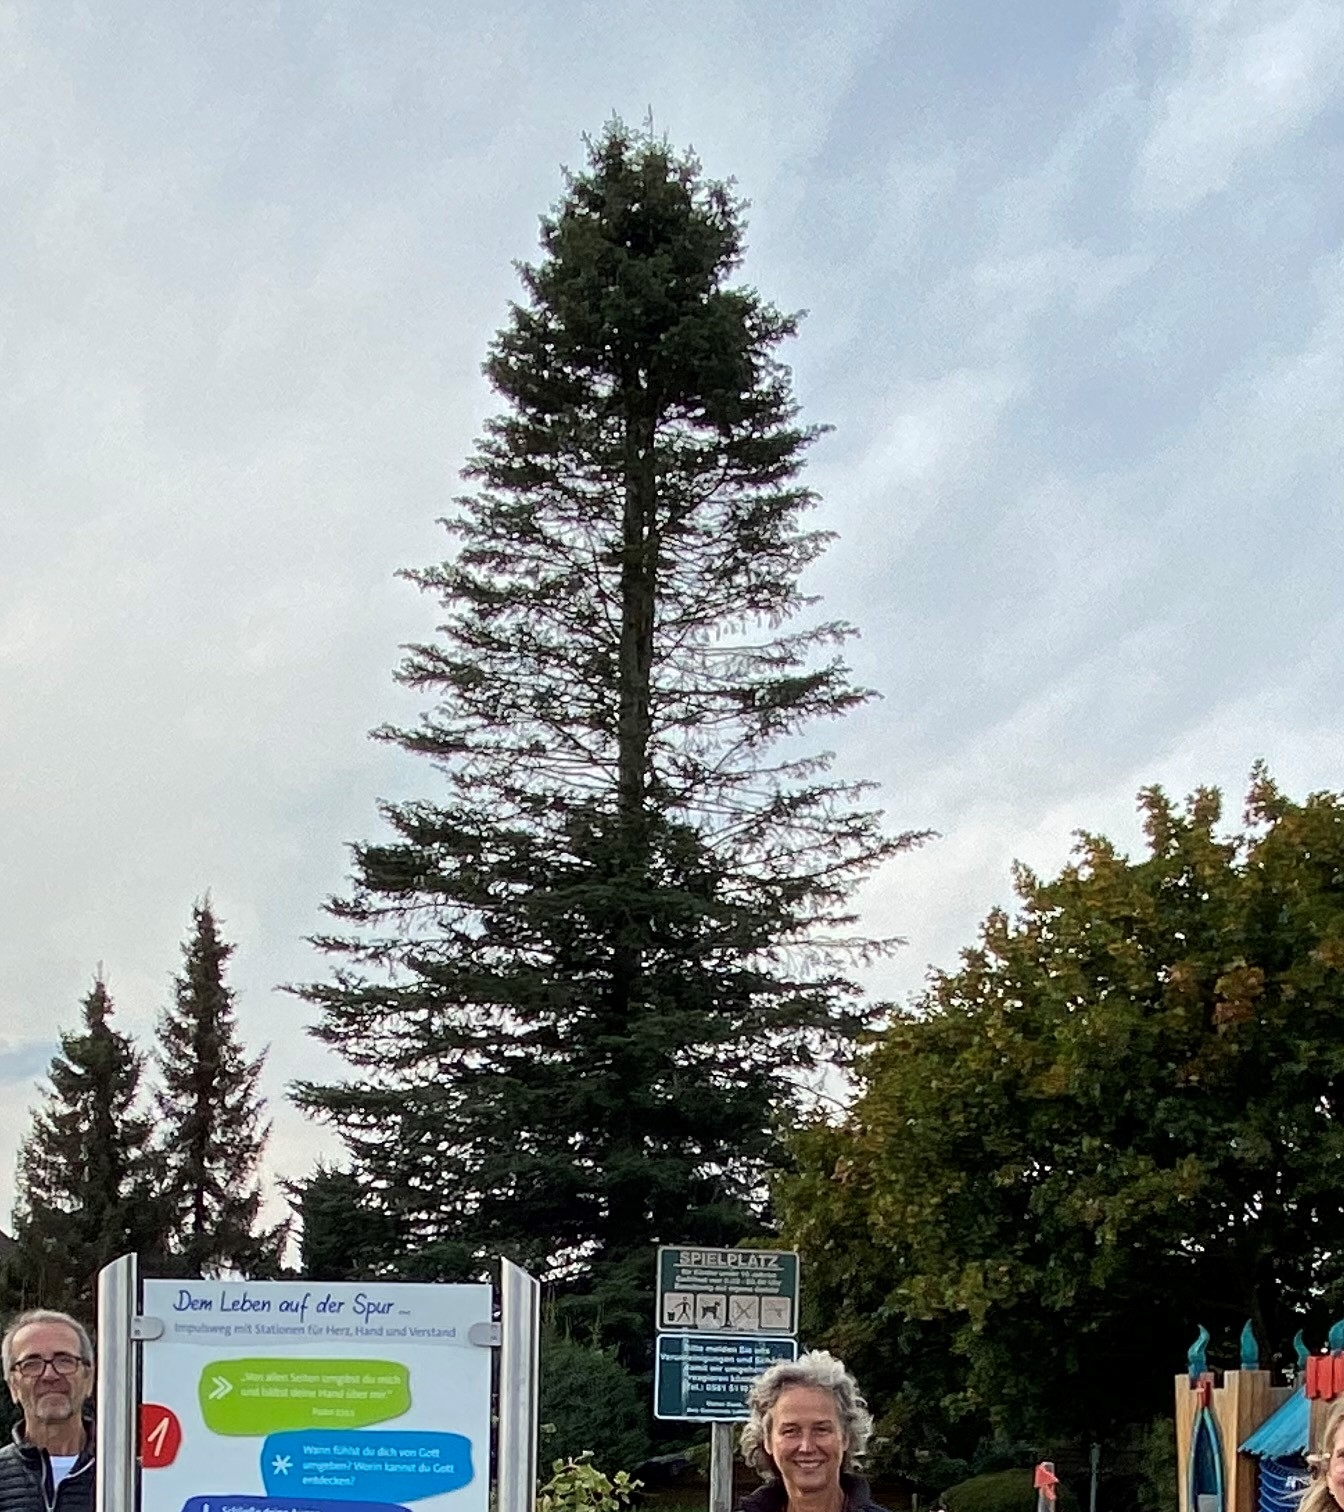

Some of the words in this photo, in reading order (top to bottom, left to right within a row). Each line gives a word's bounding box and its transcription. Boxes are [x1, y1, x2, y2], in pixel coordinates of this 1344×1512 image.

[679, 1251, 779, 1269] SPIELPLATZ
[173, 1289, 212, 1312] Dem
[220, 1290, 271, 1313] Leben
[278, 1293, 311, 1323] auf
[316, 1293, 344, 1314] der
[352, 1293, 394, 1324] Spur
[174, 1322, 231, 1336] Impulsweg
[234, 1322, 253, 1334] mit
[255, 1323, 305, 1335] Stationen
[307, 1324, 325, 1335] für
[326, 1325, 353, 1337] Herz,
[356, 1325, 383, 1337] Hand
[386, 1326, 407, 1337] und
[409, 1327, 456, 1338] Verstand
[147, 1417, 170, 1457] 1
[362, 1446, 376, 1456] du
[377, 1446, 397, 1457] dich
[399, 1448, 417, 1457] von
[418, 1447, 440, 1458] Gott
[418, 1463, 431, 1473] du
[433, 1463, 455, 1474] Gott
